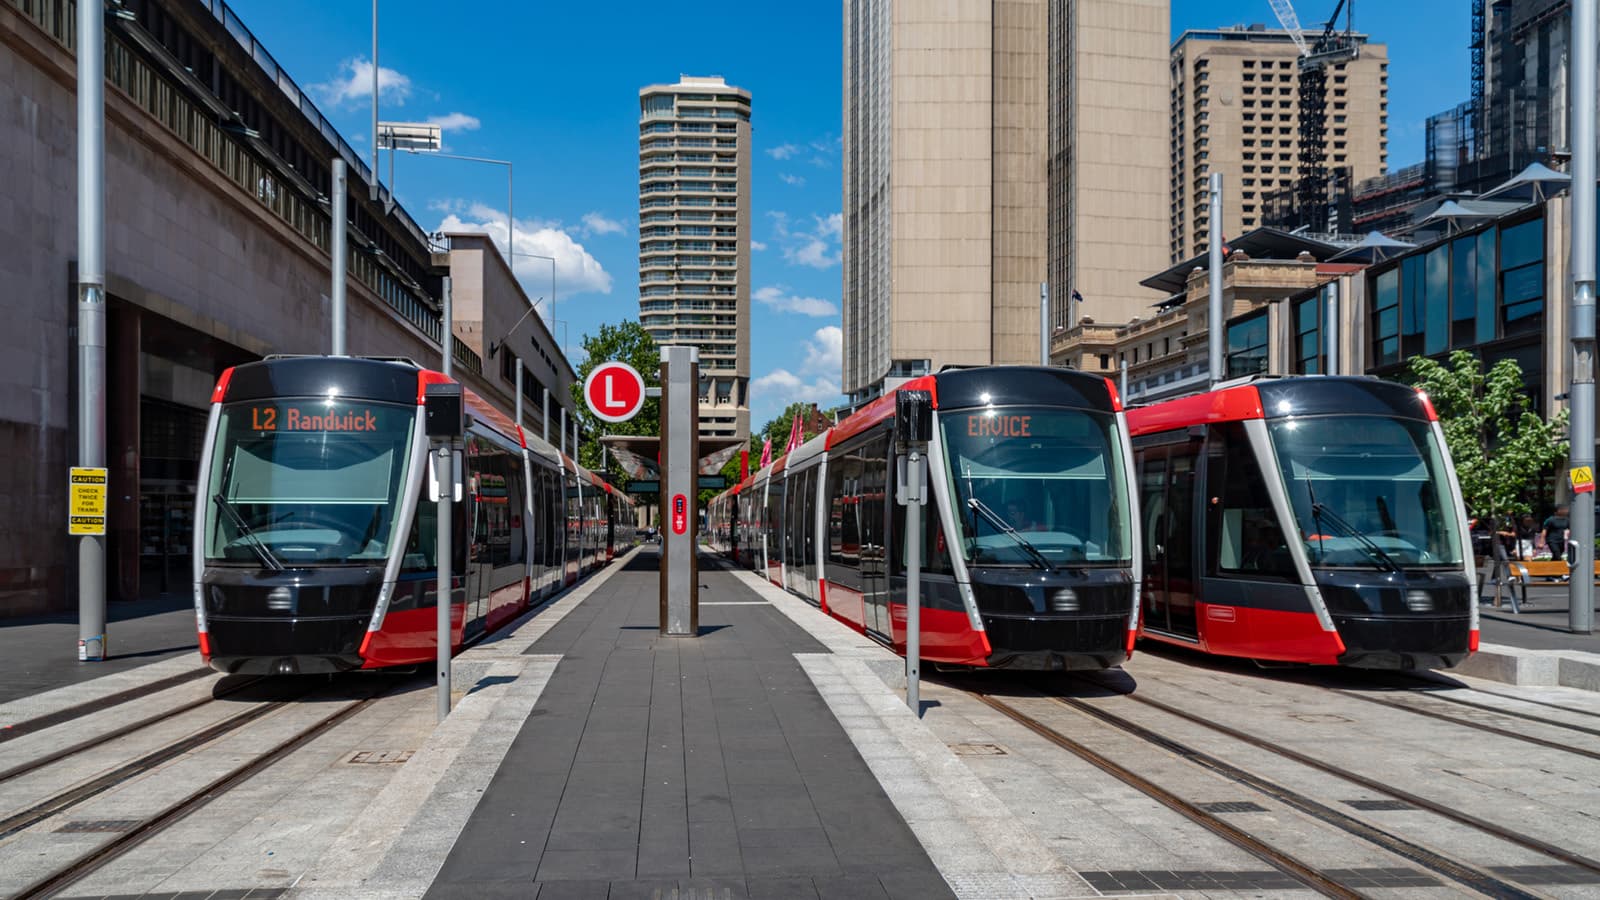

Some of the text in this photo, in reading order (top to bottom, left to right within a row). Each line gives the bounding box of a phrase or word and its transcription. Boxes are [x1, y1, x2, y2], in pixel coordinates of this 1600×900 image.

[605, 375, 626, 407] L
[252, 408, 376, 431] L2 Randwick
[968, 415, 1031, 436] ERVICE
